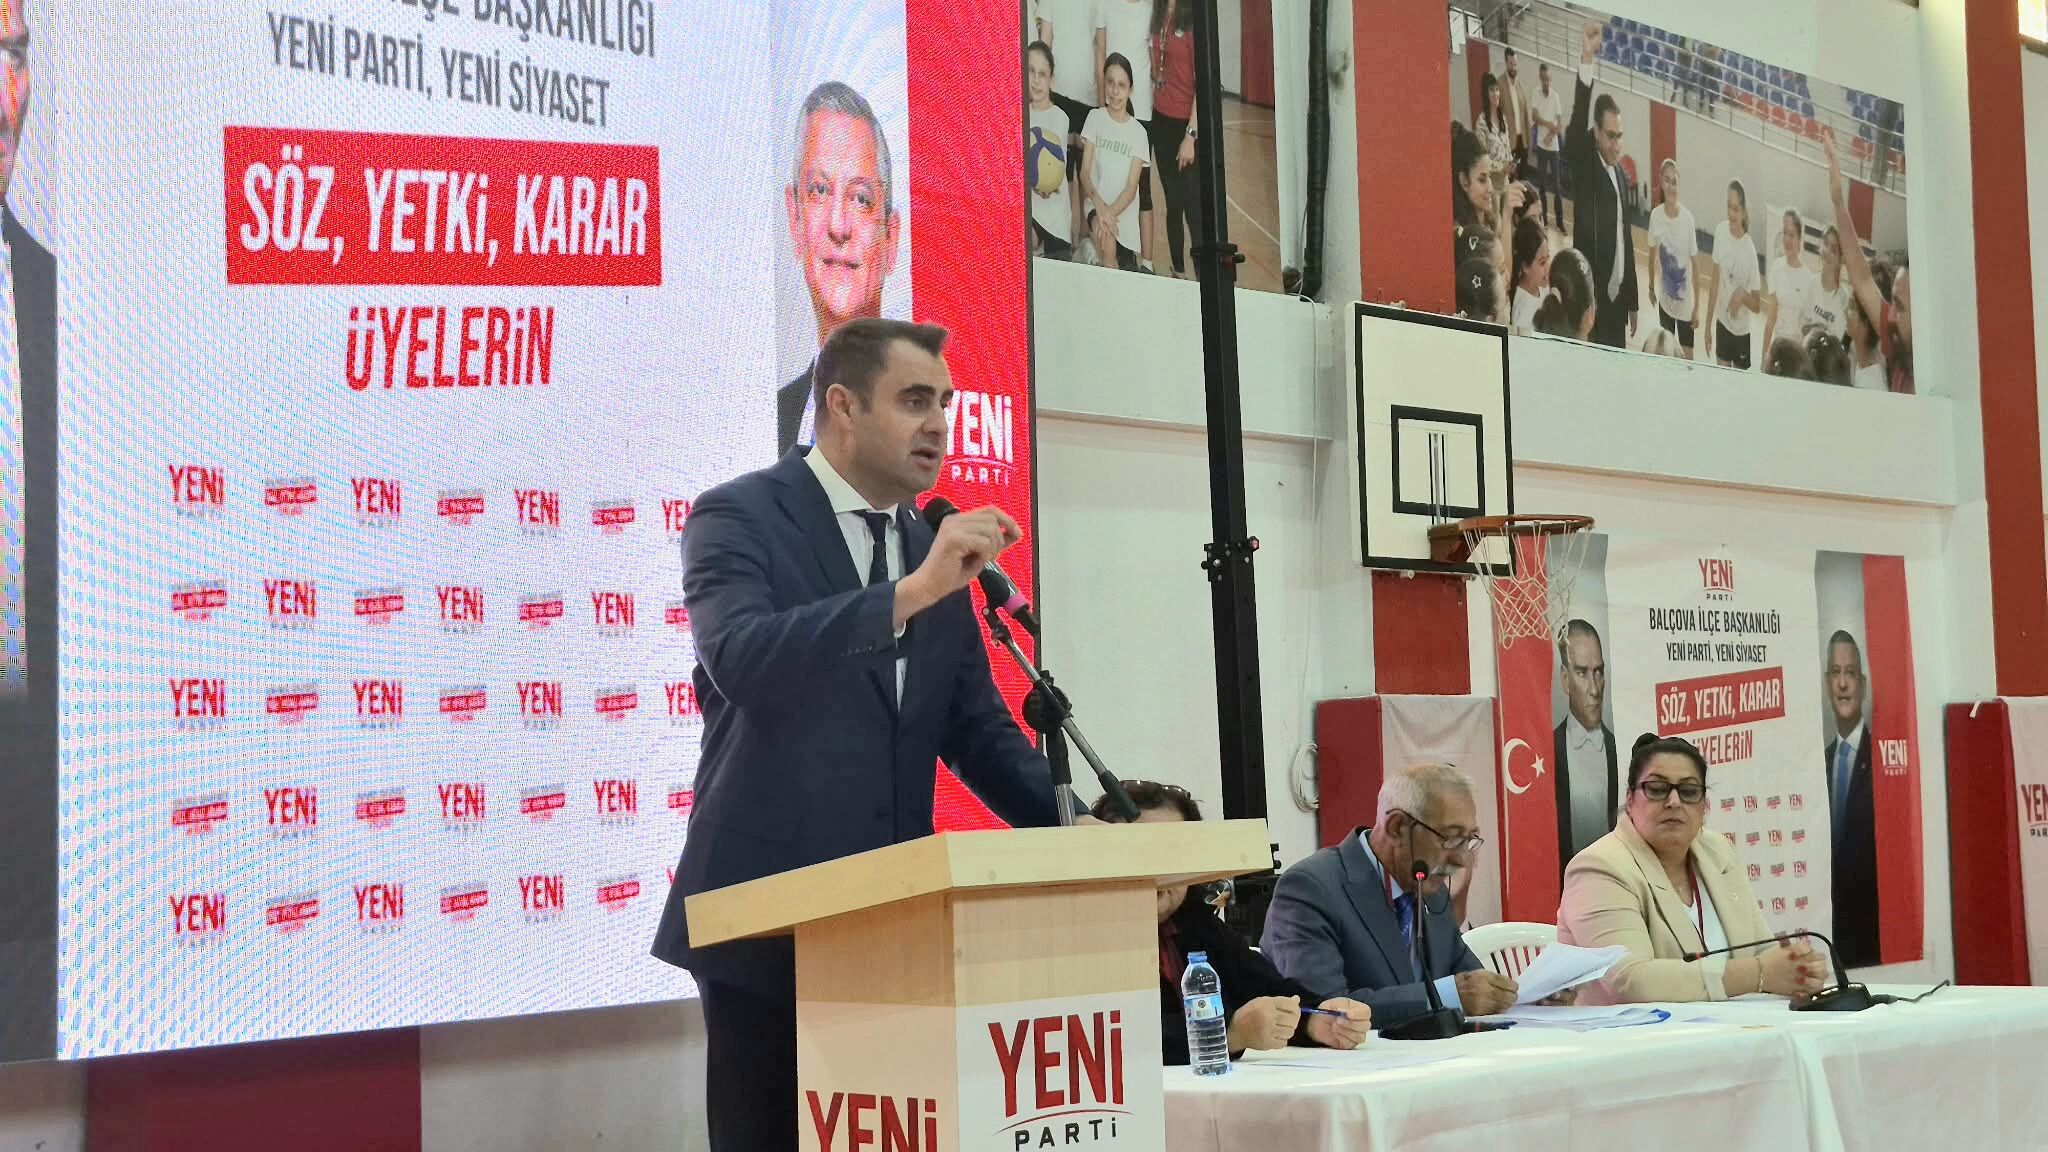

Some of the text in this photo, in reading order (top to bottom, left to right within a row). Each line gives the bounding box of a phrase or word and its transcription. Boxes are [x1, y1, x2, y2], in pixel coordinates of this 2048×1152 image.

[268, 12, 610, 128] YENİ PARTİ, YENİ SİYASET
[239, 144, 344, 266] SÖZ,
[513, 174, 648, 256] KARAR
[661, 499, 693, 533] YE
[1649, 605, 1781, 637] BALÇOVA İLÇE BAŞKANLIĞI
[1666, 640, 1686, 661] YENİ
[1715, 641, 1734, 662] YENİ
[1735, 641, 1767, 663] SİYASET
[665, 681, 702, 717] YEN
[1660, 686, 1691, 726] SÖZ,
[1739, 678, 1780, 713] KARAR
[2021, 784, 2048, 823] YEN
